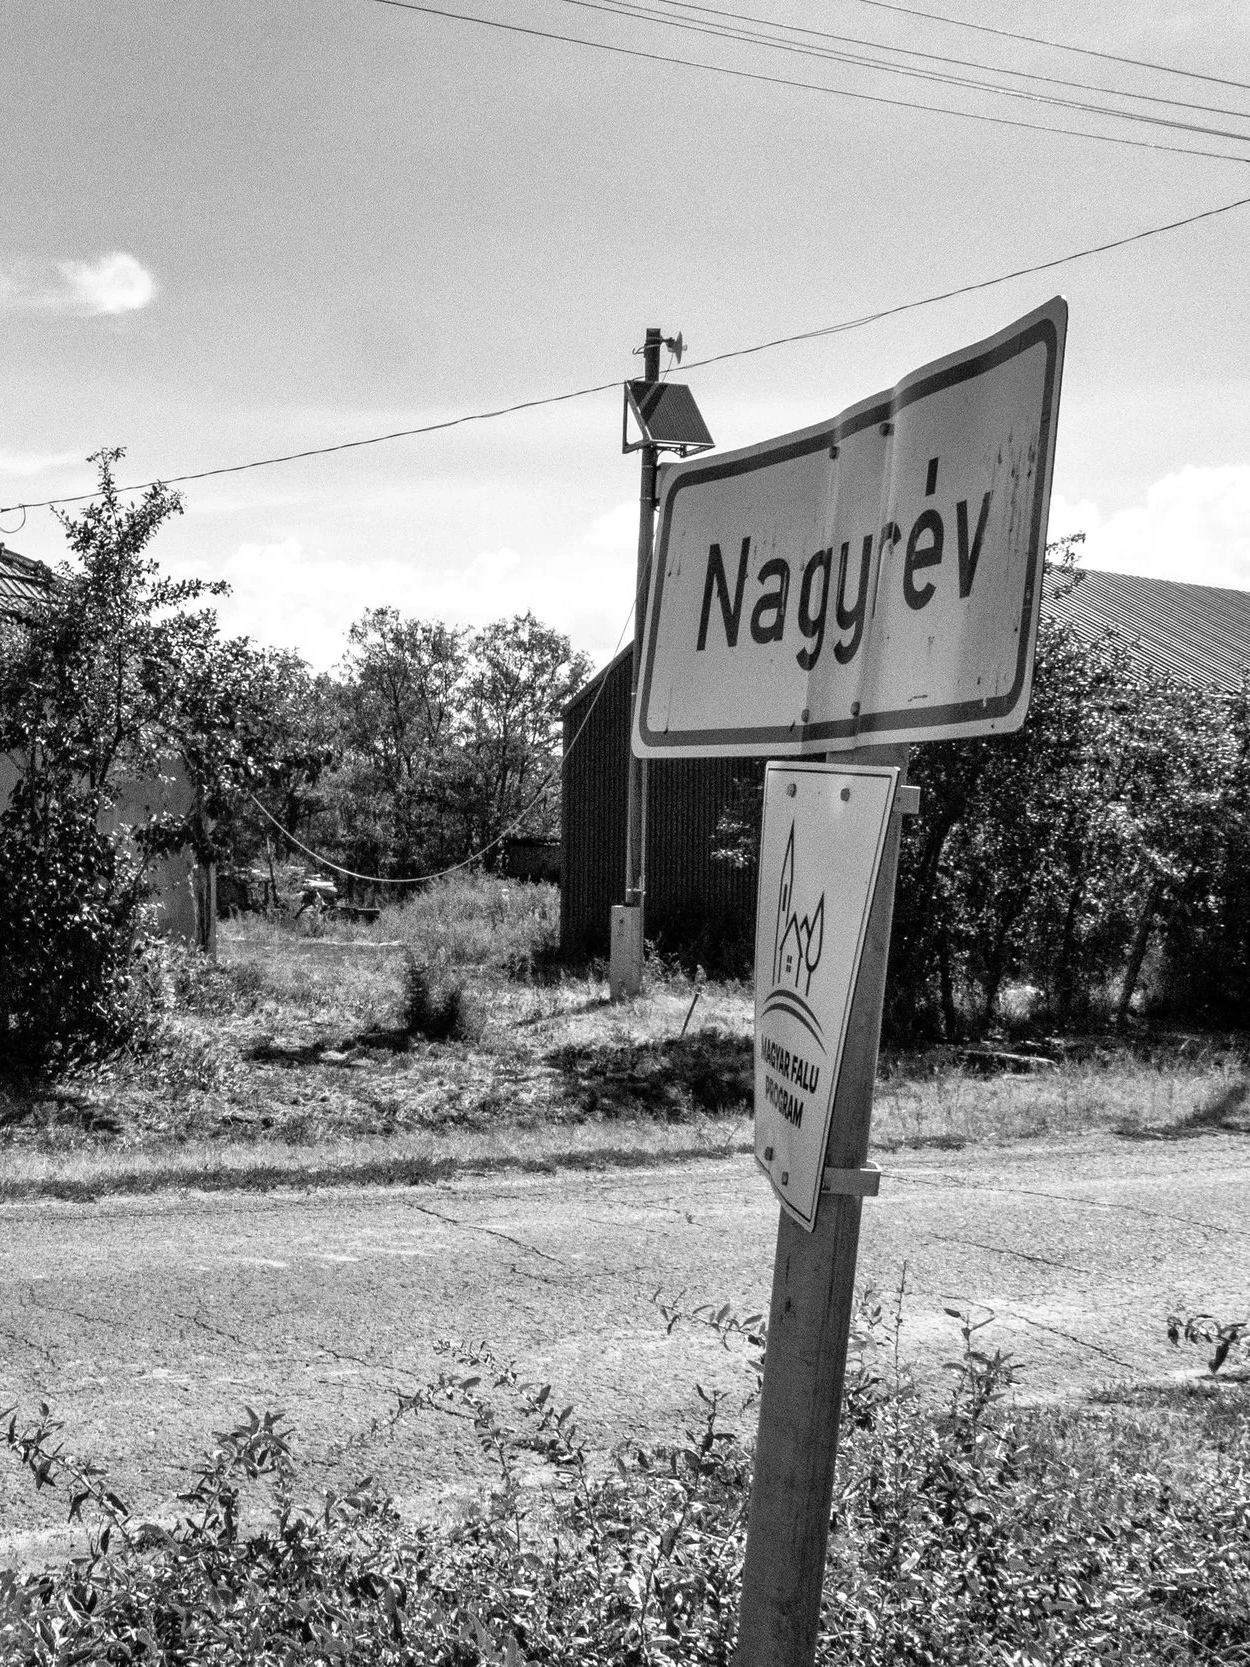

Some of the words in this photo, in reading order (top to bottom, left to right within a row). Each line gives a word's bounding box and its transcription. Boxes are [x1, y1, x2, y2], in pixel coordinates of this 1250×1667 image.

[696, 457, 993, 671] Nagyrév
[761, 1033, 791, 1079] MAGYAR
[790, 1055, 819, 1094] FALU
[765, 1074, 804, 1129] PROGRAM
